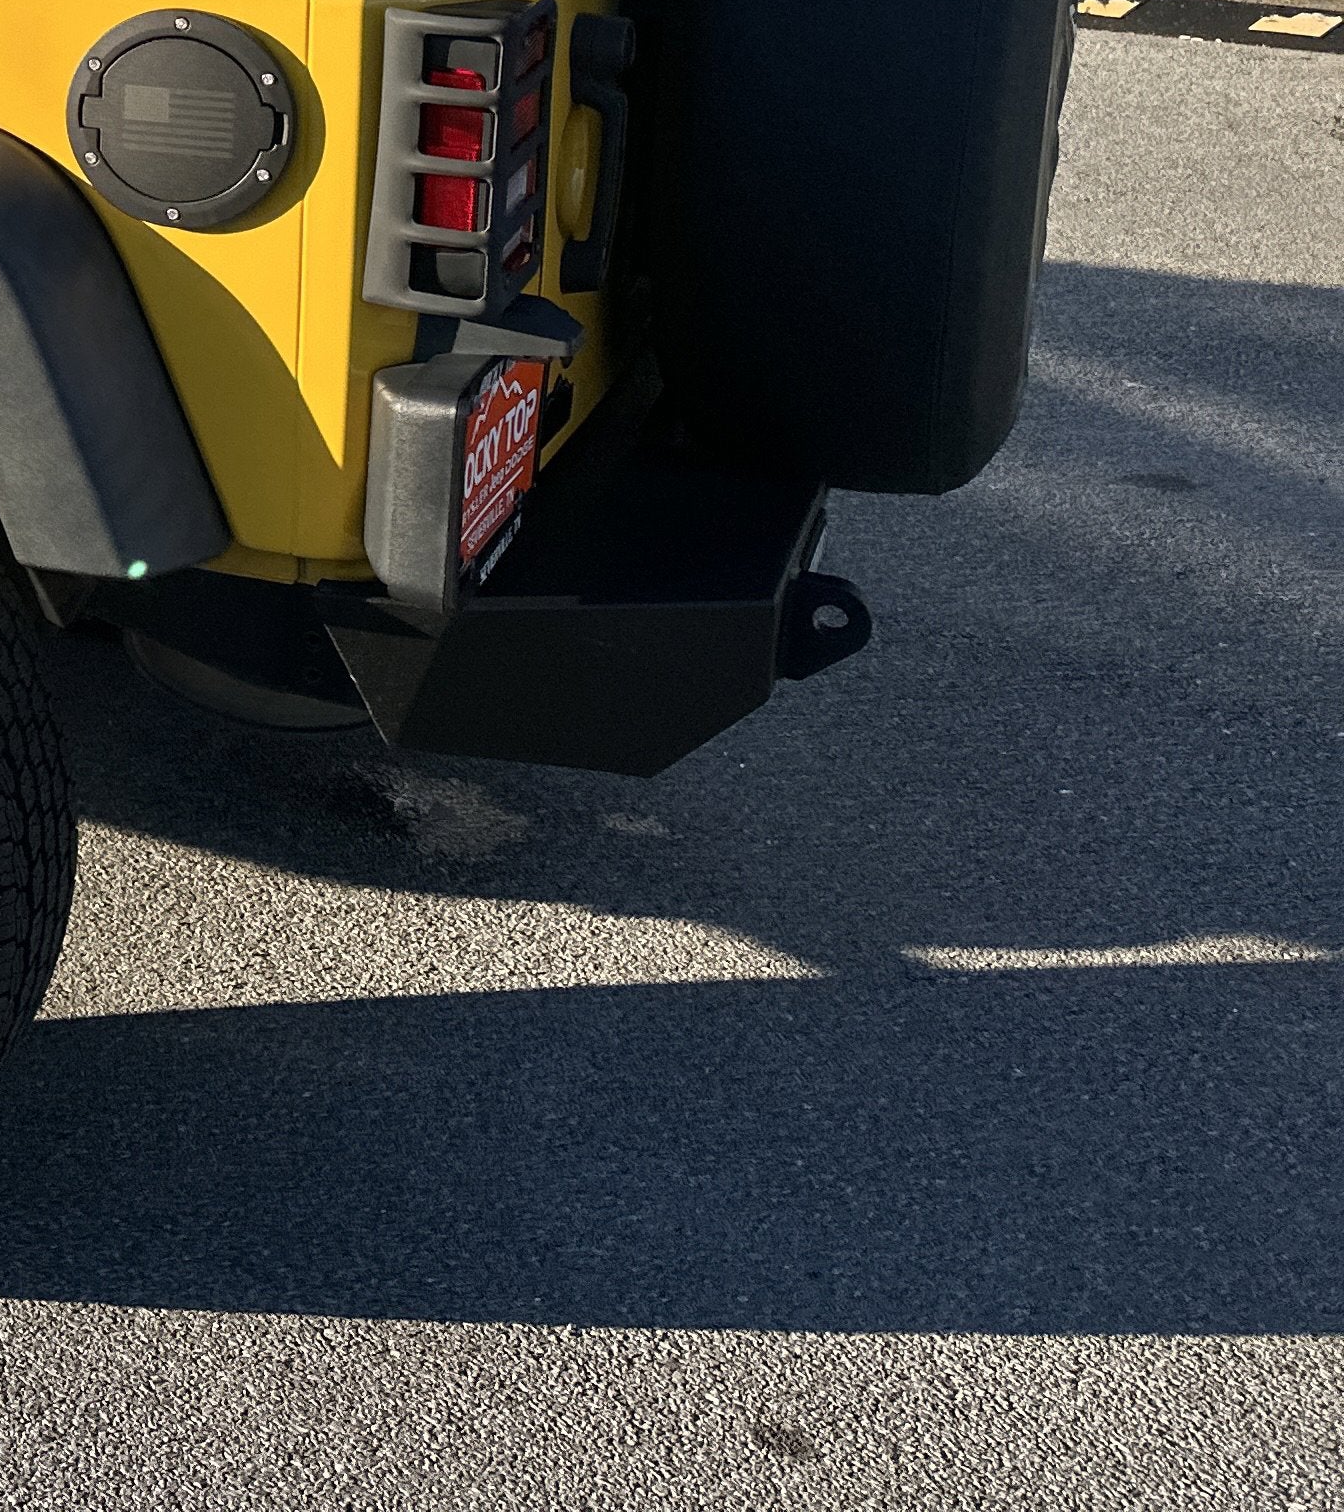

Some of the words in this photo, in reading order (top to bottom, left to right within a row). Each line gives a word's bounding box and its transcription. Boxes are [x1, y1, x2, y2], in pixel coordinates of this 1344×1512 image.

[463, 417, 503, 500] OCKY
[505, 388, 537, 453] TOP
[505, 433, 535, 475] DODGE
